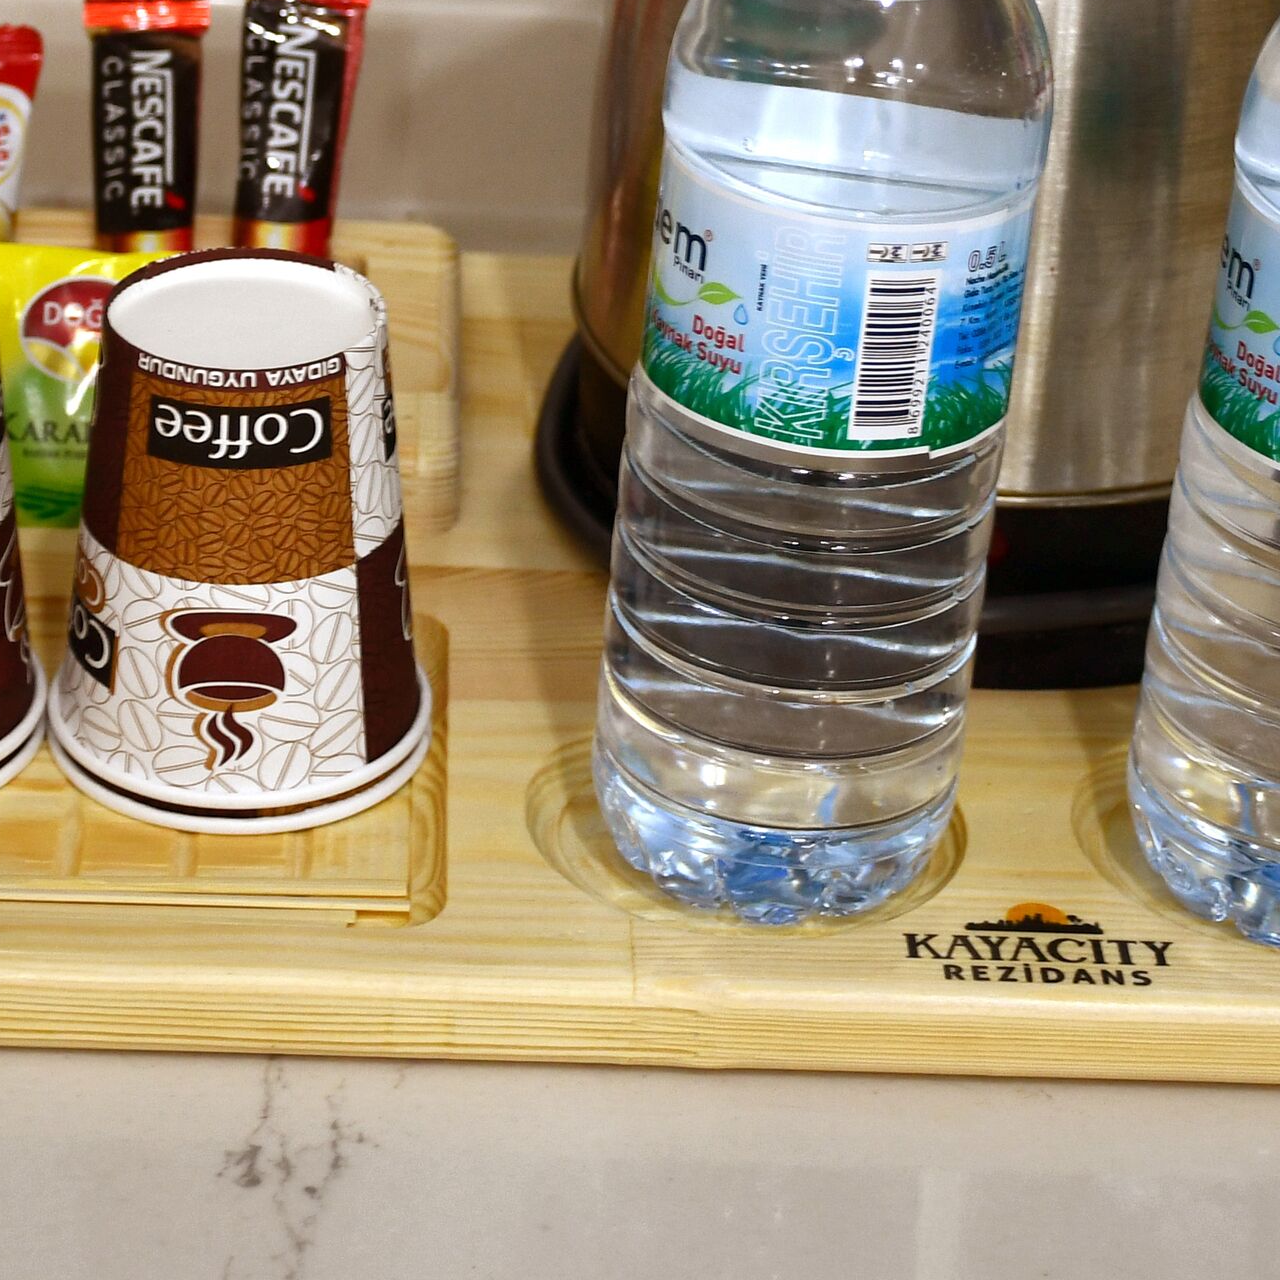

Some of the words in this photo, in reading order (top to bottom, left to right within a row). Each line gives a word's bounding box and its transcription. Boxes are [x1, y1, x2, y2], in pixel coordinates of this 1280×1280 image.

[244, 35, 267, 179] CLASSIC
[101, 55, 125, 201] CLASSIC
[692, 314, 745, 353] Doğal
[137, 352, 258, 389] UYGUNDUR
[265, 356, 341, 387] GIDAYA
[695, 341, 743, 375] Suyu
[1238, 367, 1278, 405] Suyu
[154, 404, 325, 460] Coffee
[902, 932, 1174, 967] KAYACITY
[942, 962, 1153, 986] REZİDANS
